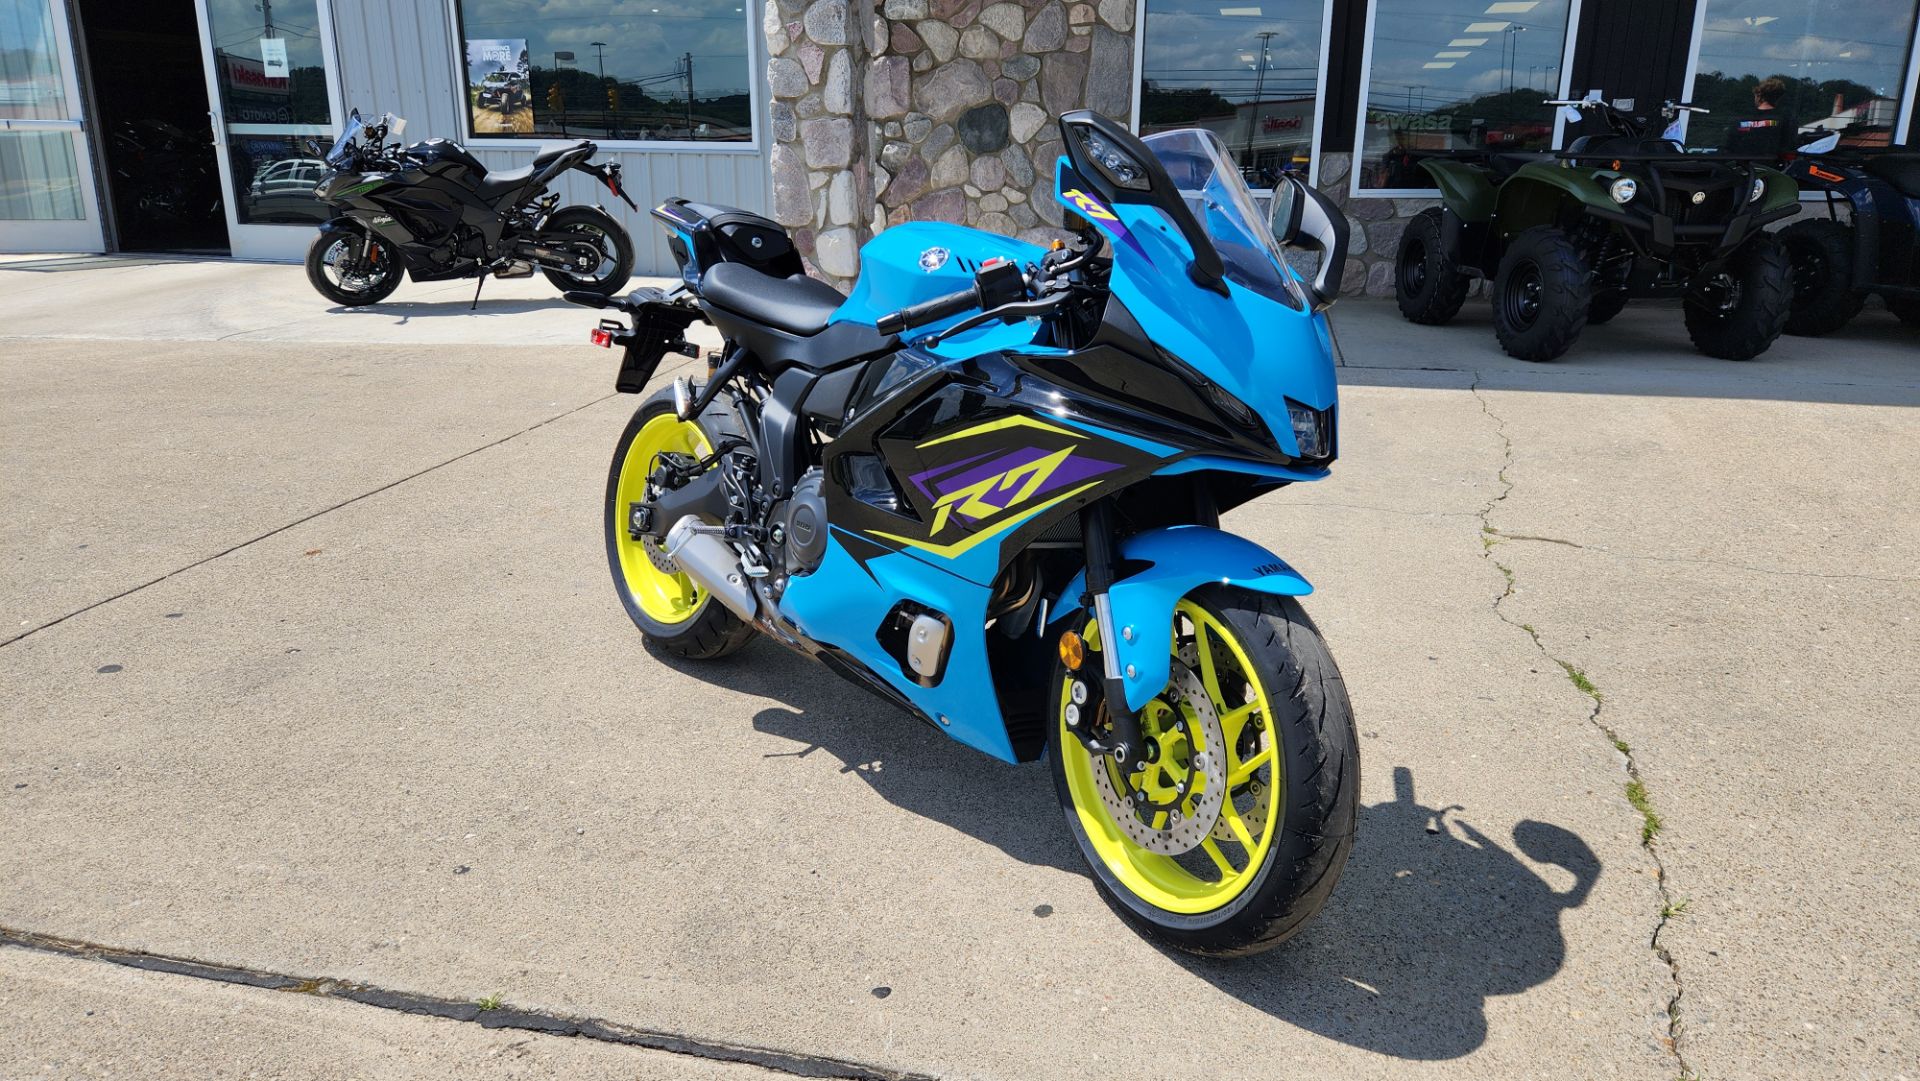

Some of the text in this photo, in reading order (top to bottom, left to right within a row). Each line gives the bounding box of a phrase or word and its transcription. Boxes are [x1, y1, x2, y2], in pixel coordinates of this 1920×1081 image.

[483, 51, 511, 61] MORE
[1063, 189, 1118, 220] R7
[929, 444, 1078, 537] R7
